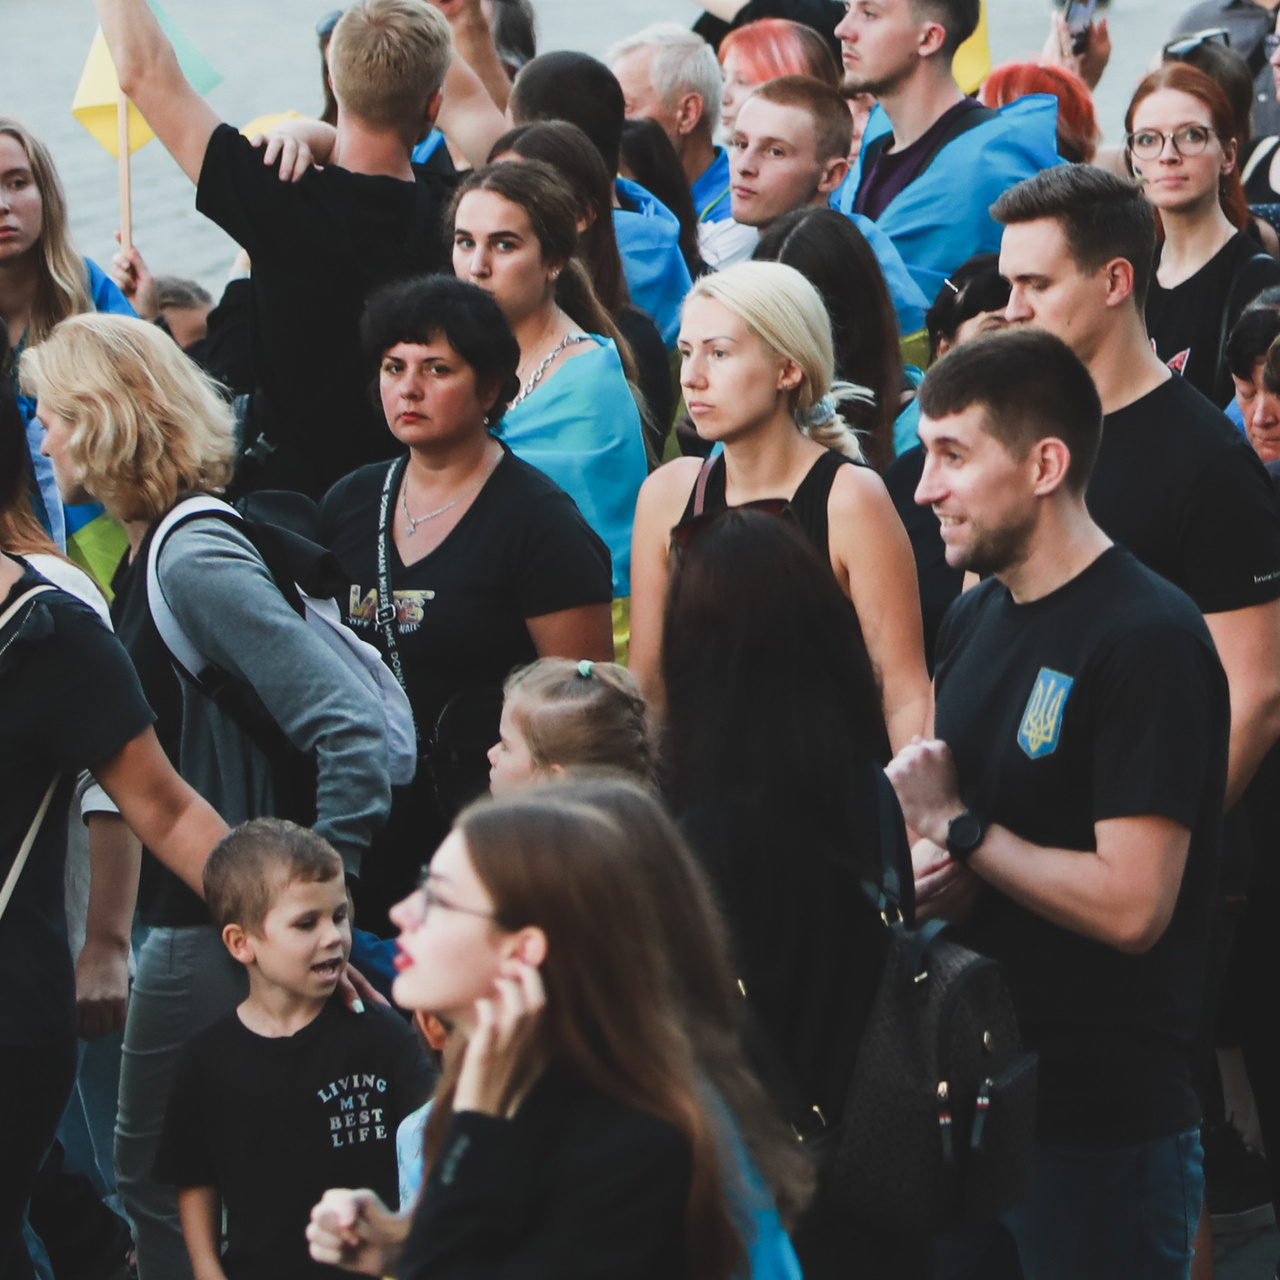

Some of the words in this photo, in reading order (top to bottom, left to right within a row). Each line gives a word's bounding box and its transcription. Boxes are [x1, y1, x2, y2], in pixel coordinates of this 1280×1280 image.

[317, 1074, 387, 1104] LIVING
[340, 1092, 370, 1111] MY
[329, 1108, 383, 1131] BEST
[331, 1125, 387, 1148] LIFE
